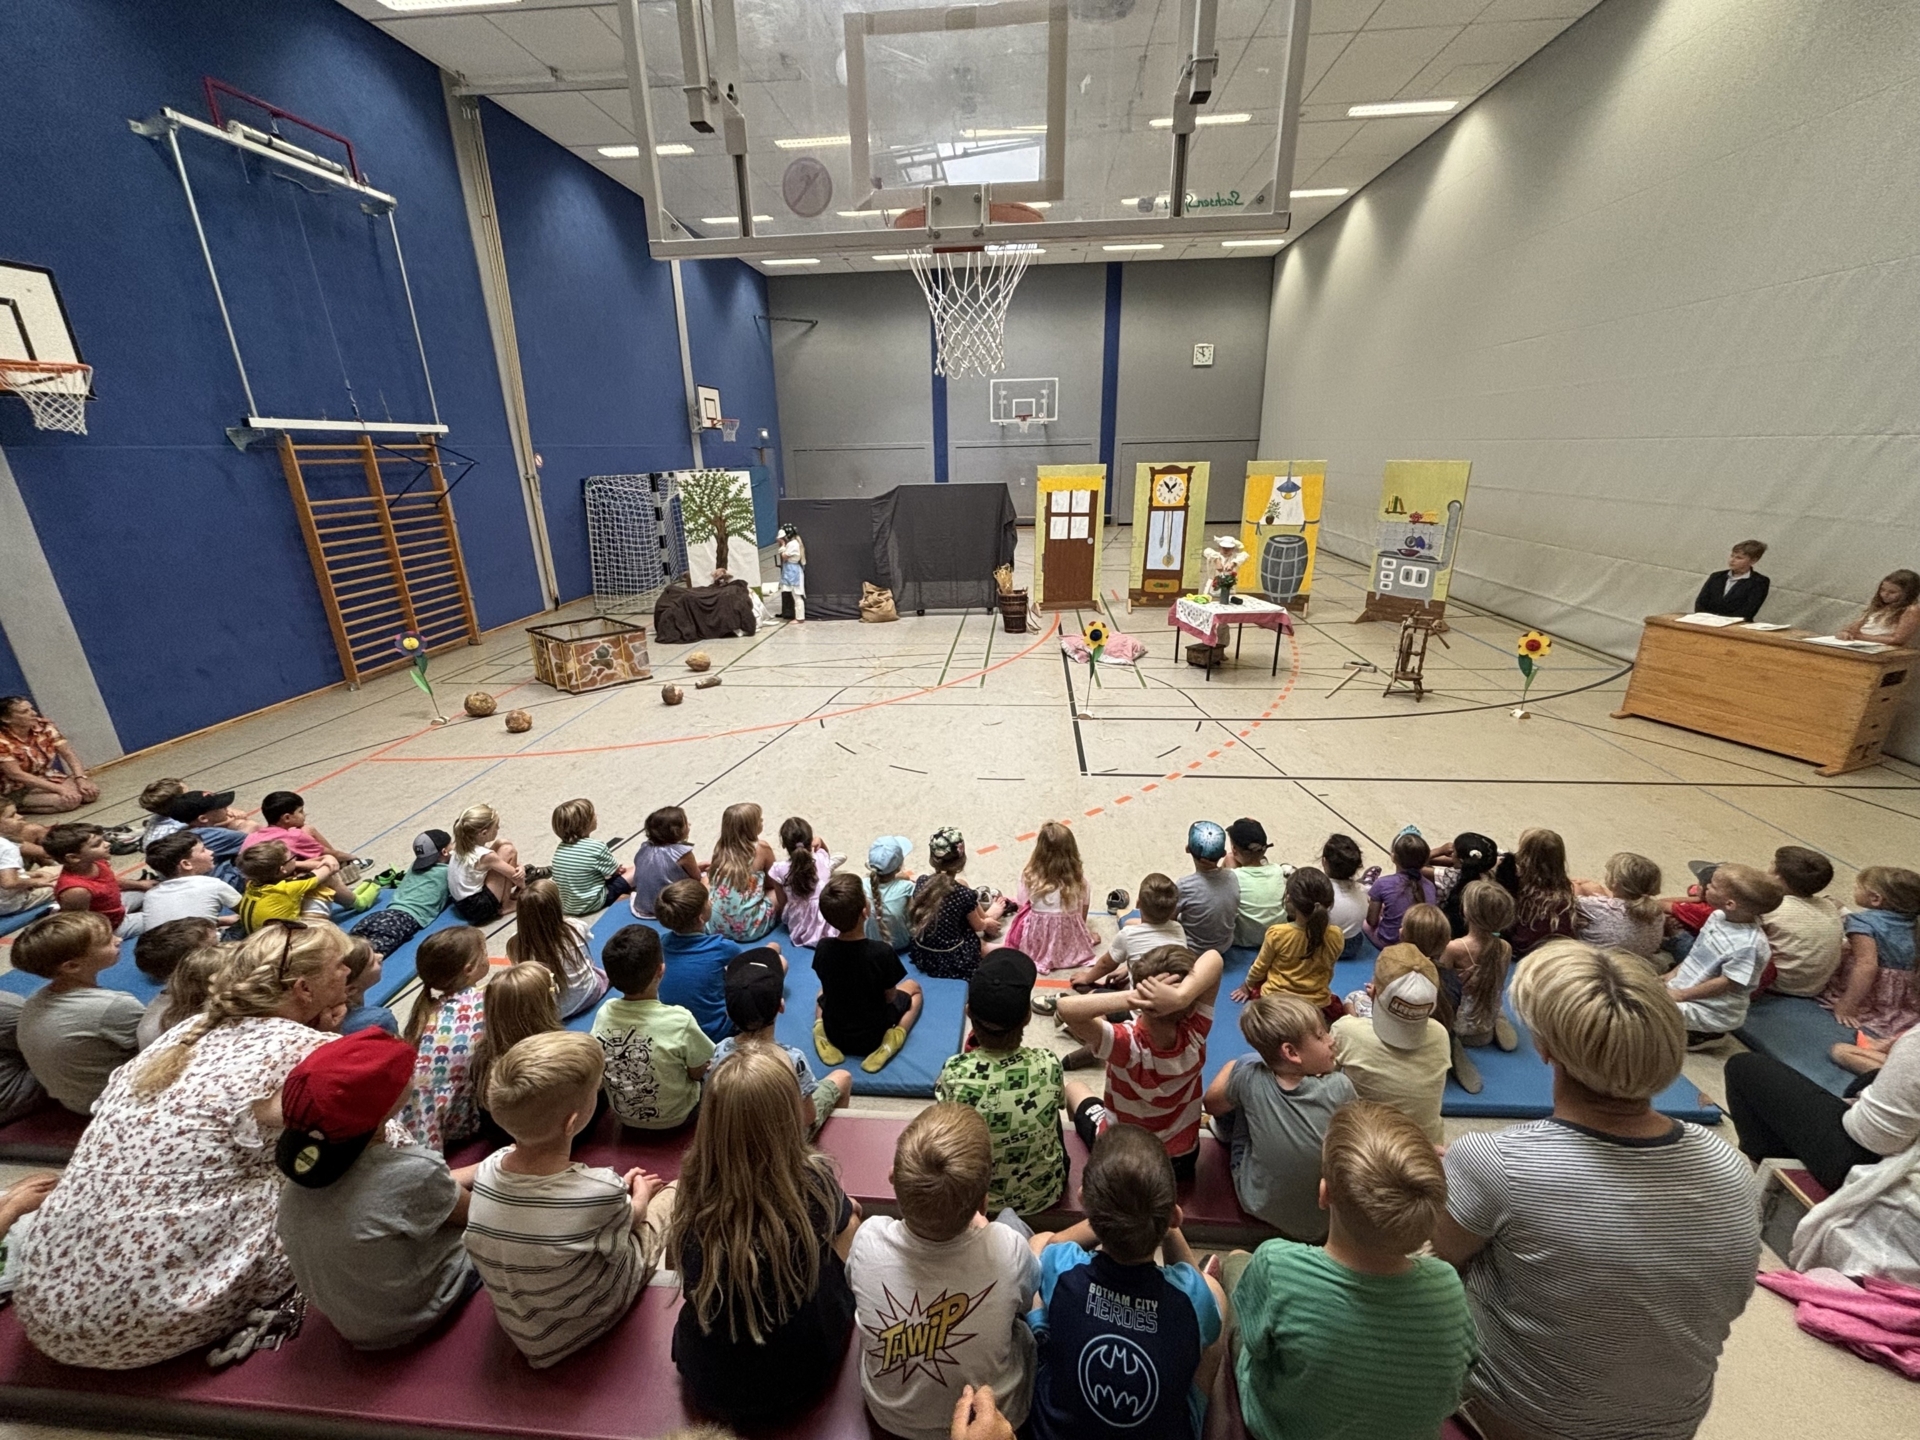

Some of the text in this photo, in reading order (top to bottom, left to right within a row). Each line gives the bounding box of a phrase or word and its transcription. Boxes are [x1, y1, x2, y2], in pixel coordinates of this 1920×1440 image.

[1085, 1292, 1158, 1334] HEROES
[1088, 1281, 1159, 1312] GOTHAM CITY
